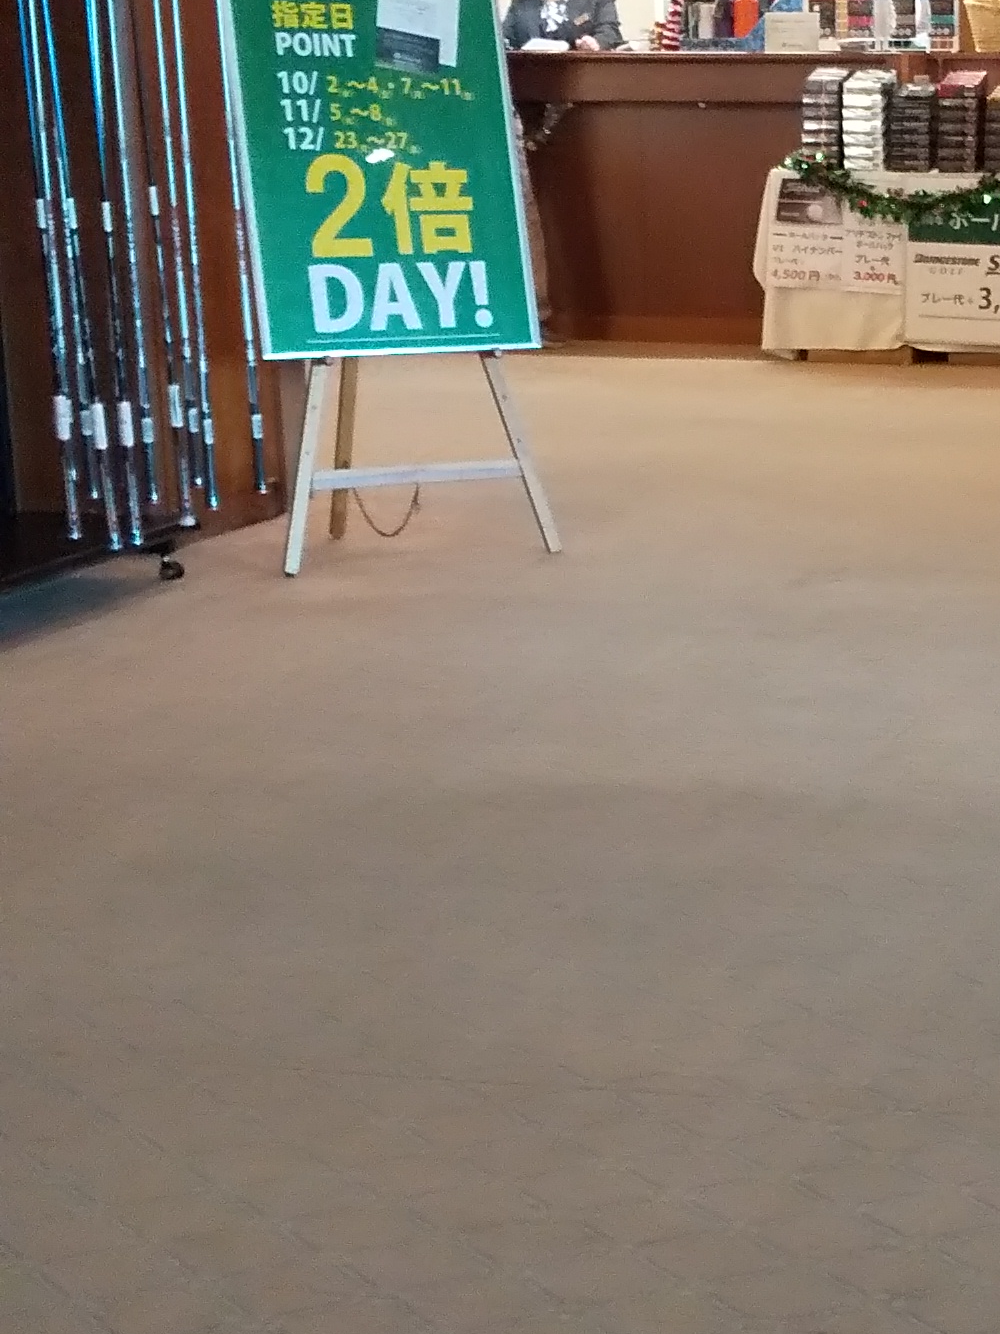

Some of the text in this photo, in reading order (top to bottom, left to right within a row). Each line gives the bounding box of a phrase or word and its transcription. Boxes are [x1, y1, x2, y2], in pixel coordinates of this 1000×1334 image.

[271, 1, 353, 29] 指定日
[275, 32, 356, 57] POINT
[277, 71, 318, 95] 10/
[280, 98, 321, 123] 11/
[283, 126, 324, 151] 12/
[307, 260, 493, 334] DAY!
